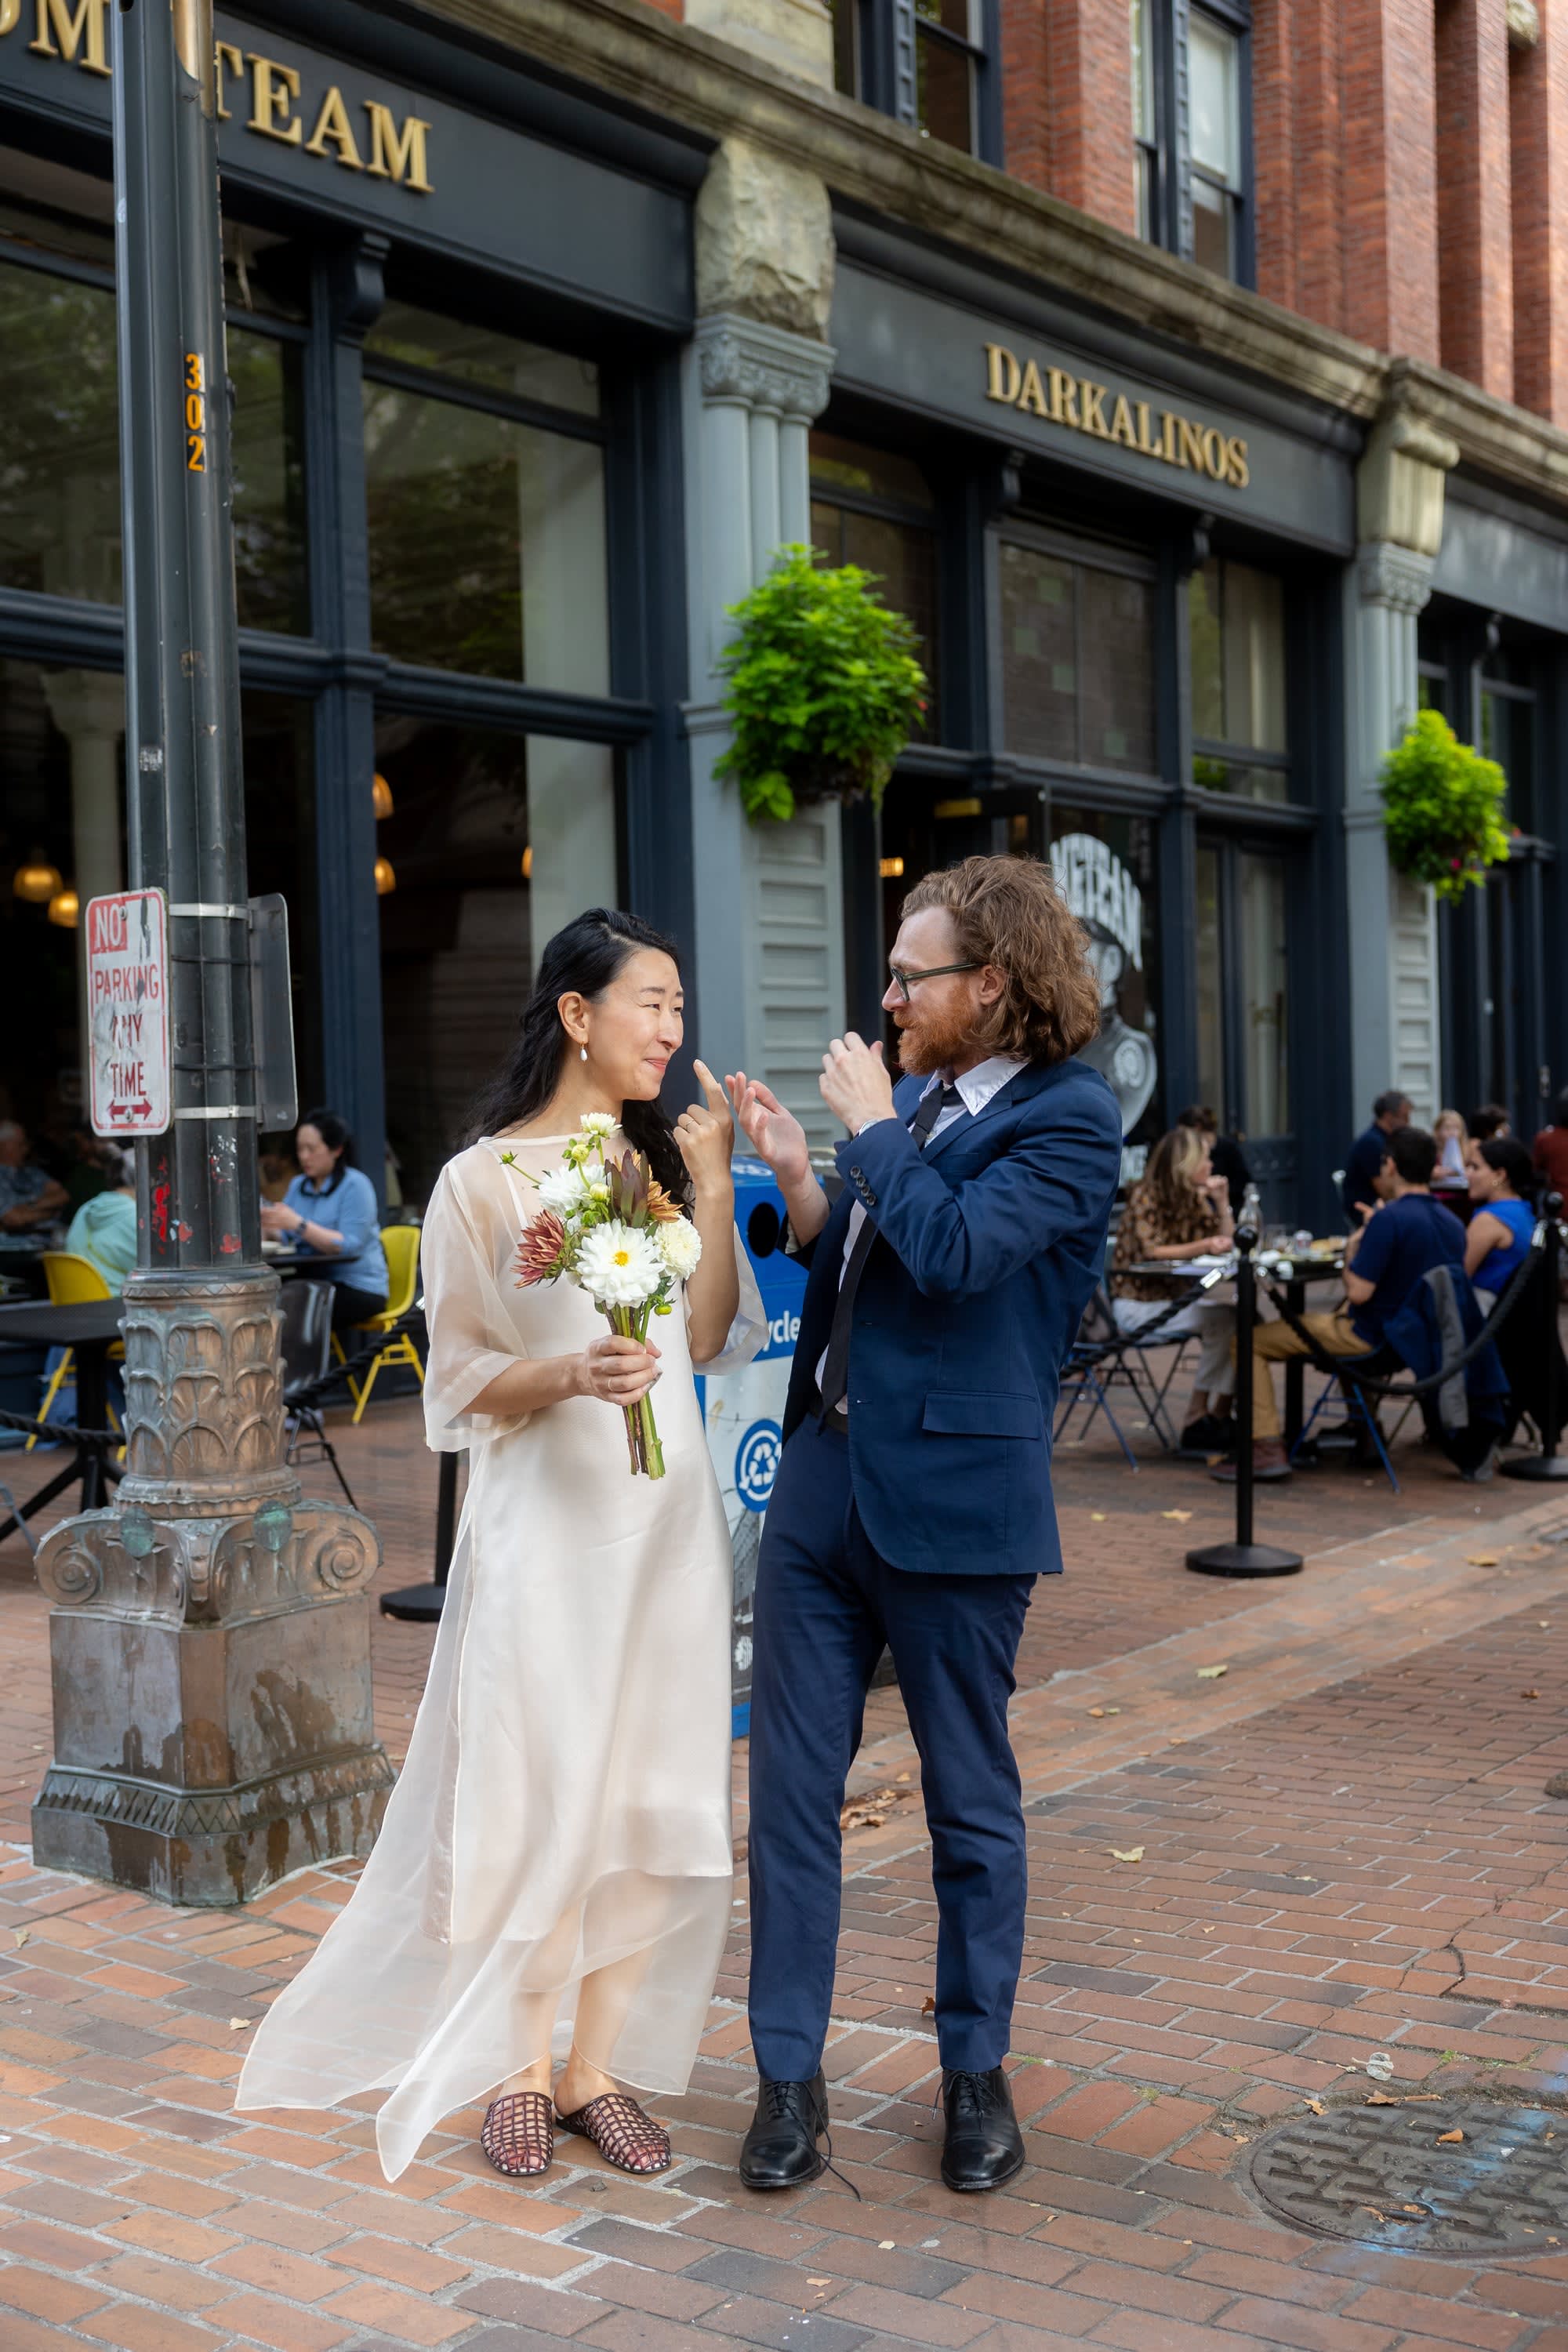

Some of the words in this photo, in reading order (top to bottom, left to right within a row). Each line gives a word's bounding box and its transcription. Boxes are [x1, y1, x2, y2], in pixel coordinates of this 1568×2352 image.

[0, 0, 113, 76] M
[185, 354, 205, 472] 302
[985, 342, 1250, 489] DARKALINOS
[96, 903, 122, 949] NO
[95, 964, 159, 1004] PARKING
[110, 1062, 147, 1098] TIME
